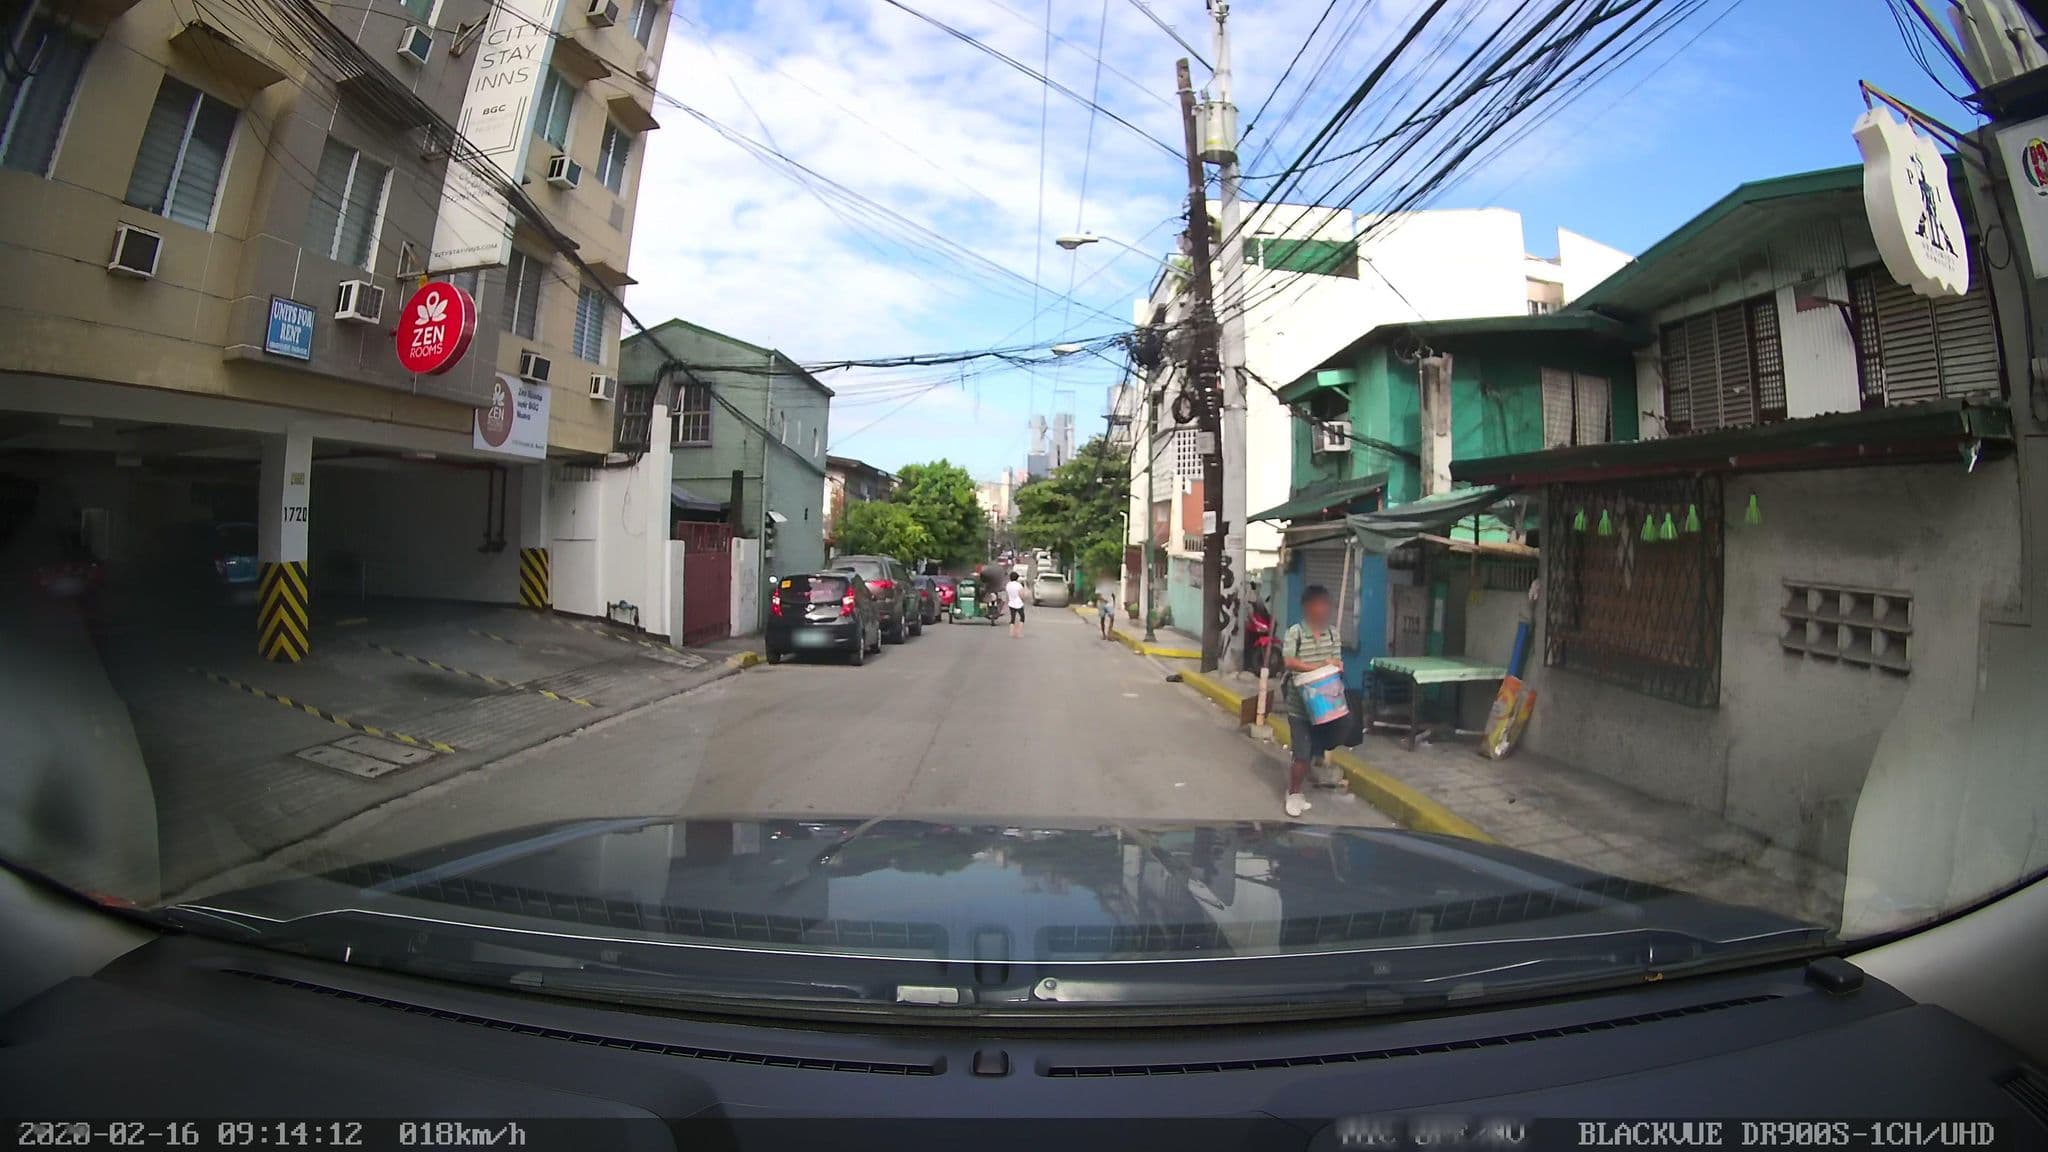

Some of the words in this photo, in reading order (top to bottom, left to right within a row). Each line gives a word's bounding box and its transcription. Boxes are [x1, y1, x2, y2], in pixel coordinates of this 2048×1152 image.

[488, 23, 544, 45] CITY
[481, 43, 537, 69] STAY
[474, 66, 529, 93] INNS
[482, 104, 506, 115] BGC
[273, 301, 298, 324] UNITS
[297, 308, 313, 328] FOR
[280, 322, 301, 344] RENT
[411, 324, 445, 347] ZEN
[409, 343, 443, 358] ROOMS
[488, 406, 505, 420] ZEN
[284, 506, 308, 522] 1720
